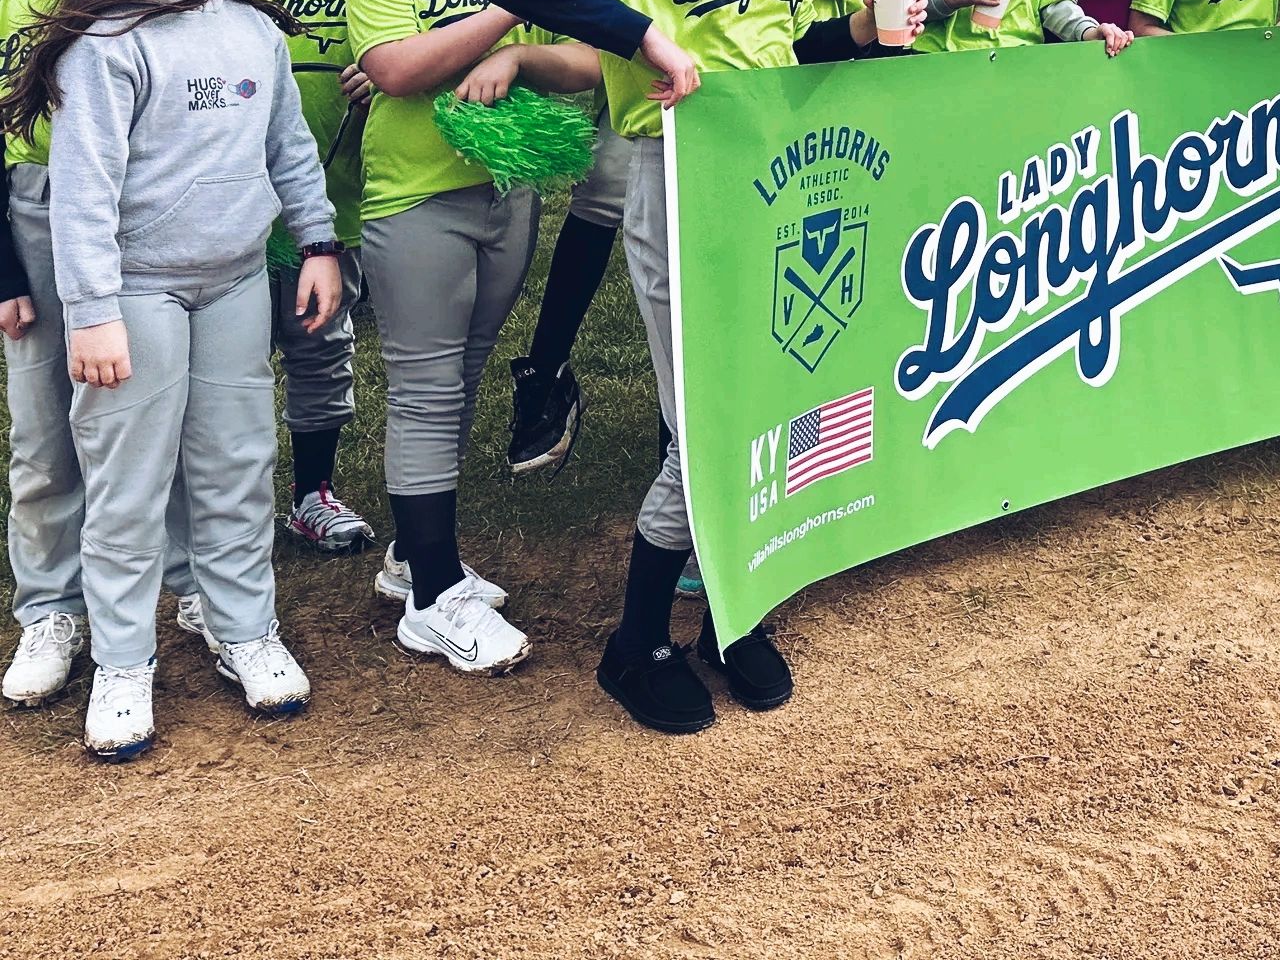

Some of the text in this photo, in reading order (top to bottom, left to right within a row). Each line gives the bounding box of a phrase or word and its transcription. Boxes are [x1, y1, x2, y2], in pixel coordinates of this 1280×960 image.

[186, 76, 224, 93] HUGS
[188, 97, 227, 112] MASKS
[752, 126, 891, 208] LONGHORNS
[799, 167, 850, 191] ATHLETIC
[999, 126, 1098, 221] LADY
[806, 187, 844, 208] ASSOC.
[776, 203, 871, 241] EST. 2014
[783, 273, 855, 326] V H
[750, 423, 783, 489] KY
[749, 479, 779, 524] USA
[747, 494, 876, 574] villahillslonghorns.com
